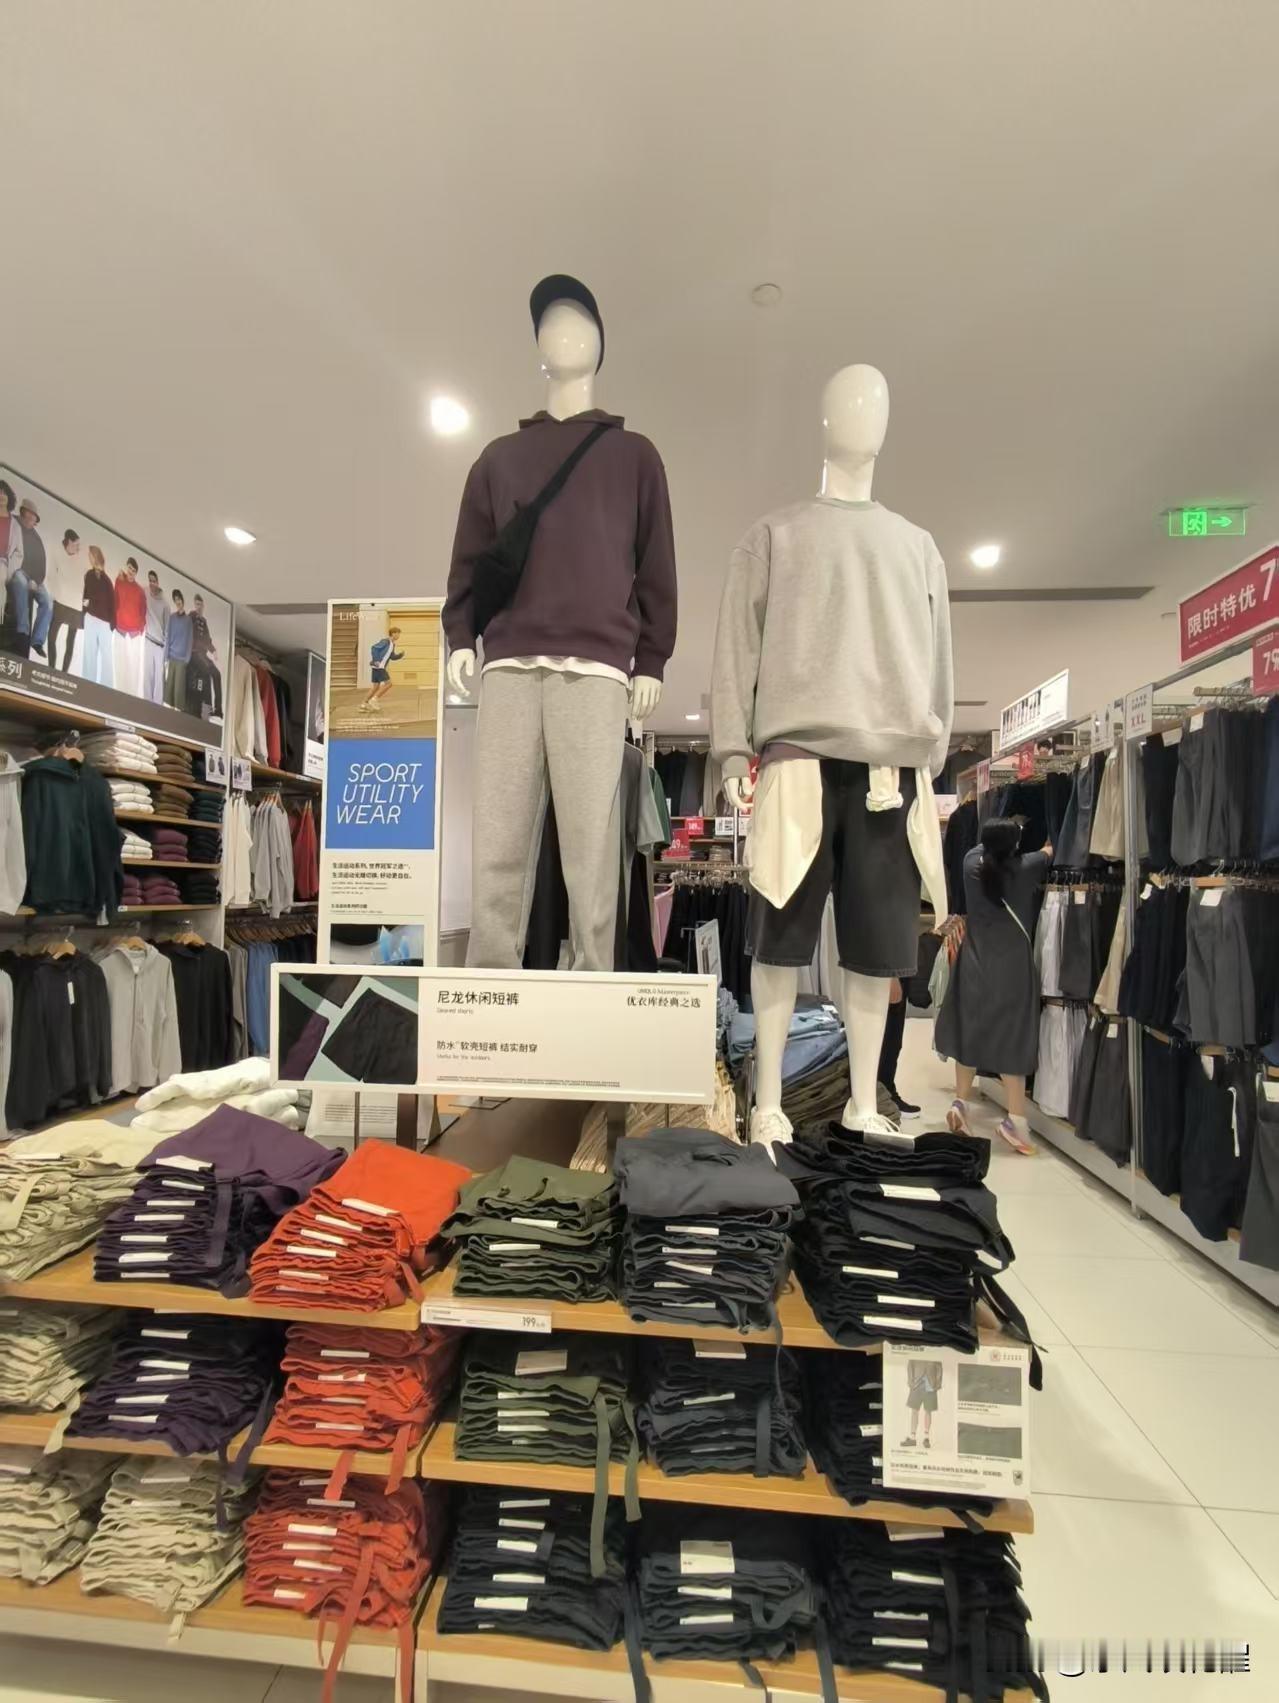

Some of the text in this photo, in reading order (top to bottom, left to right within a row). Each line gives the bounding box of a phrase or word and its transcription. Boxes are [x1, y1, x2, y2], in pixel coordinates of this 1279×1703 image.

[1187, 584, 1257, 640] 限时特优
[348, 763, 422, 782] SPORT
[343, 784, 424, 803] UTILITY
[337, 805, 401, 824] WEAR
[437, 990, 520, 1006] 尼龙休闲短裤
[626, 996, 701, 1008] 优衣库经典之选
[500, 1043, 538, 1053] 结实耐穿
[522, 1316, 537, 1327] 199
